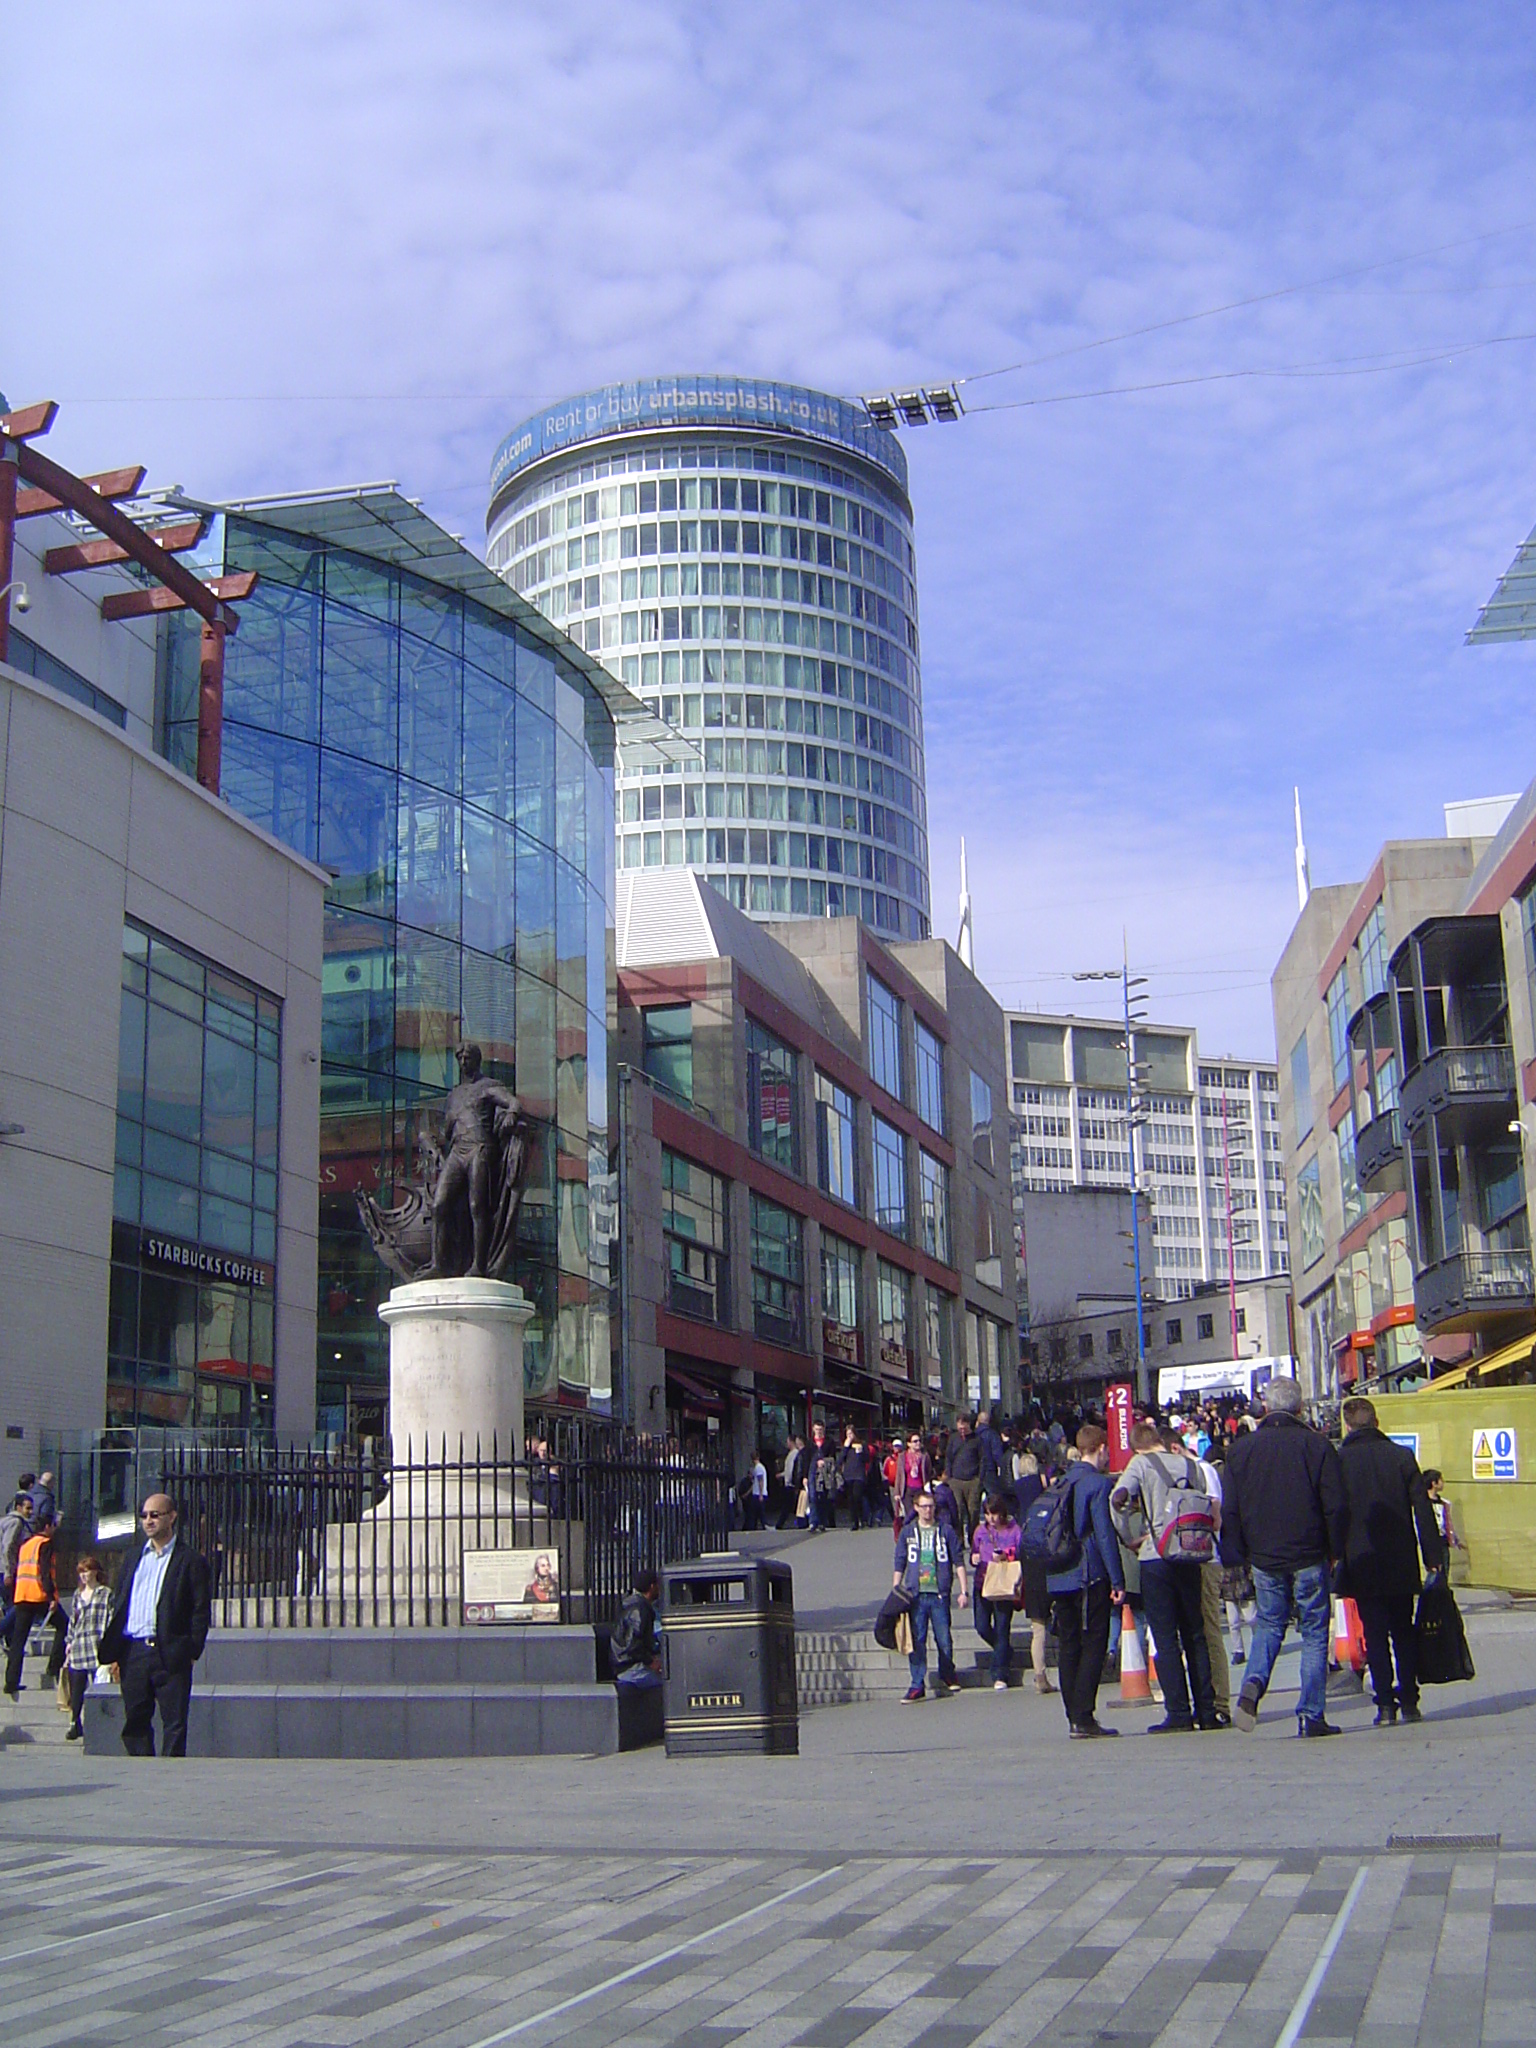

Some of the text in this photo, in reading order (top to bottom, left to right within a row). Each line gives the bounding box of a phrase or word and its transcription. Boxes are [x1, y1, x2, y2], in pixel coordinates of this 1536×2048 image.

[546, 388, 839, 437] Rent or buy urbansplash.co.uk
[149, 1239, 266, 1286] STARBUCKS COFFEE
[1116, 1388, 1128, 1405] 2
[908, 1544, 917, 1563] 6
[691, 1694, 742, 1707] LITTER
